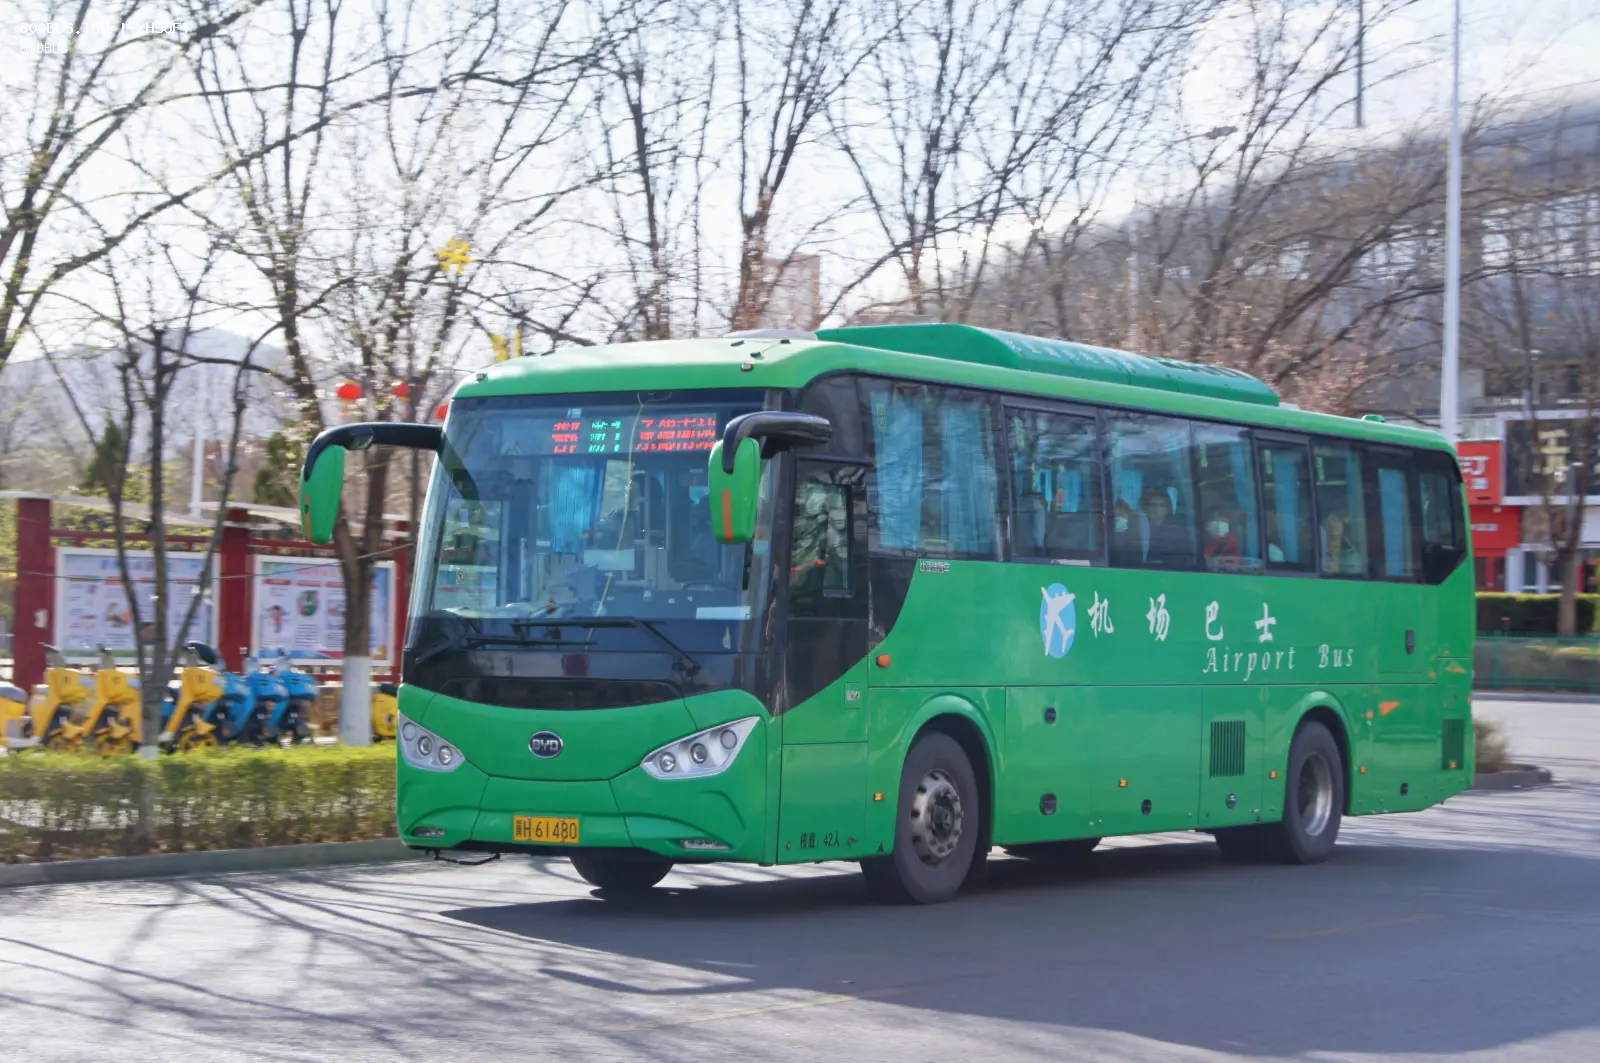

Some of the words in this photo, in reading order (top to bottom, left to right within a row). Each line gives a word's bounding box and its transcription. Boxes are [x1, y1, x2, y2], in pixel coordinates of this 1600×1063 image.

[1087, 590, 1276, 643] 机场巴士
[1202, 644, 1296, 681] Airport
[1317, 643, 1354, 668] Bus
[532, 738, 559, 751] BYD
